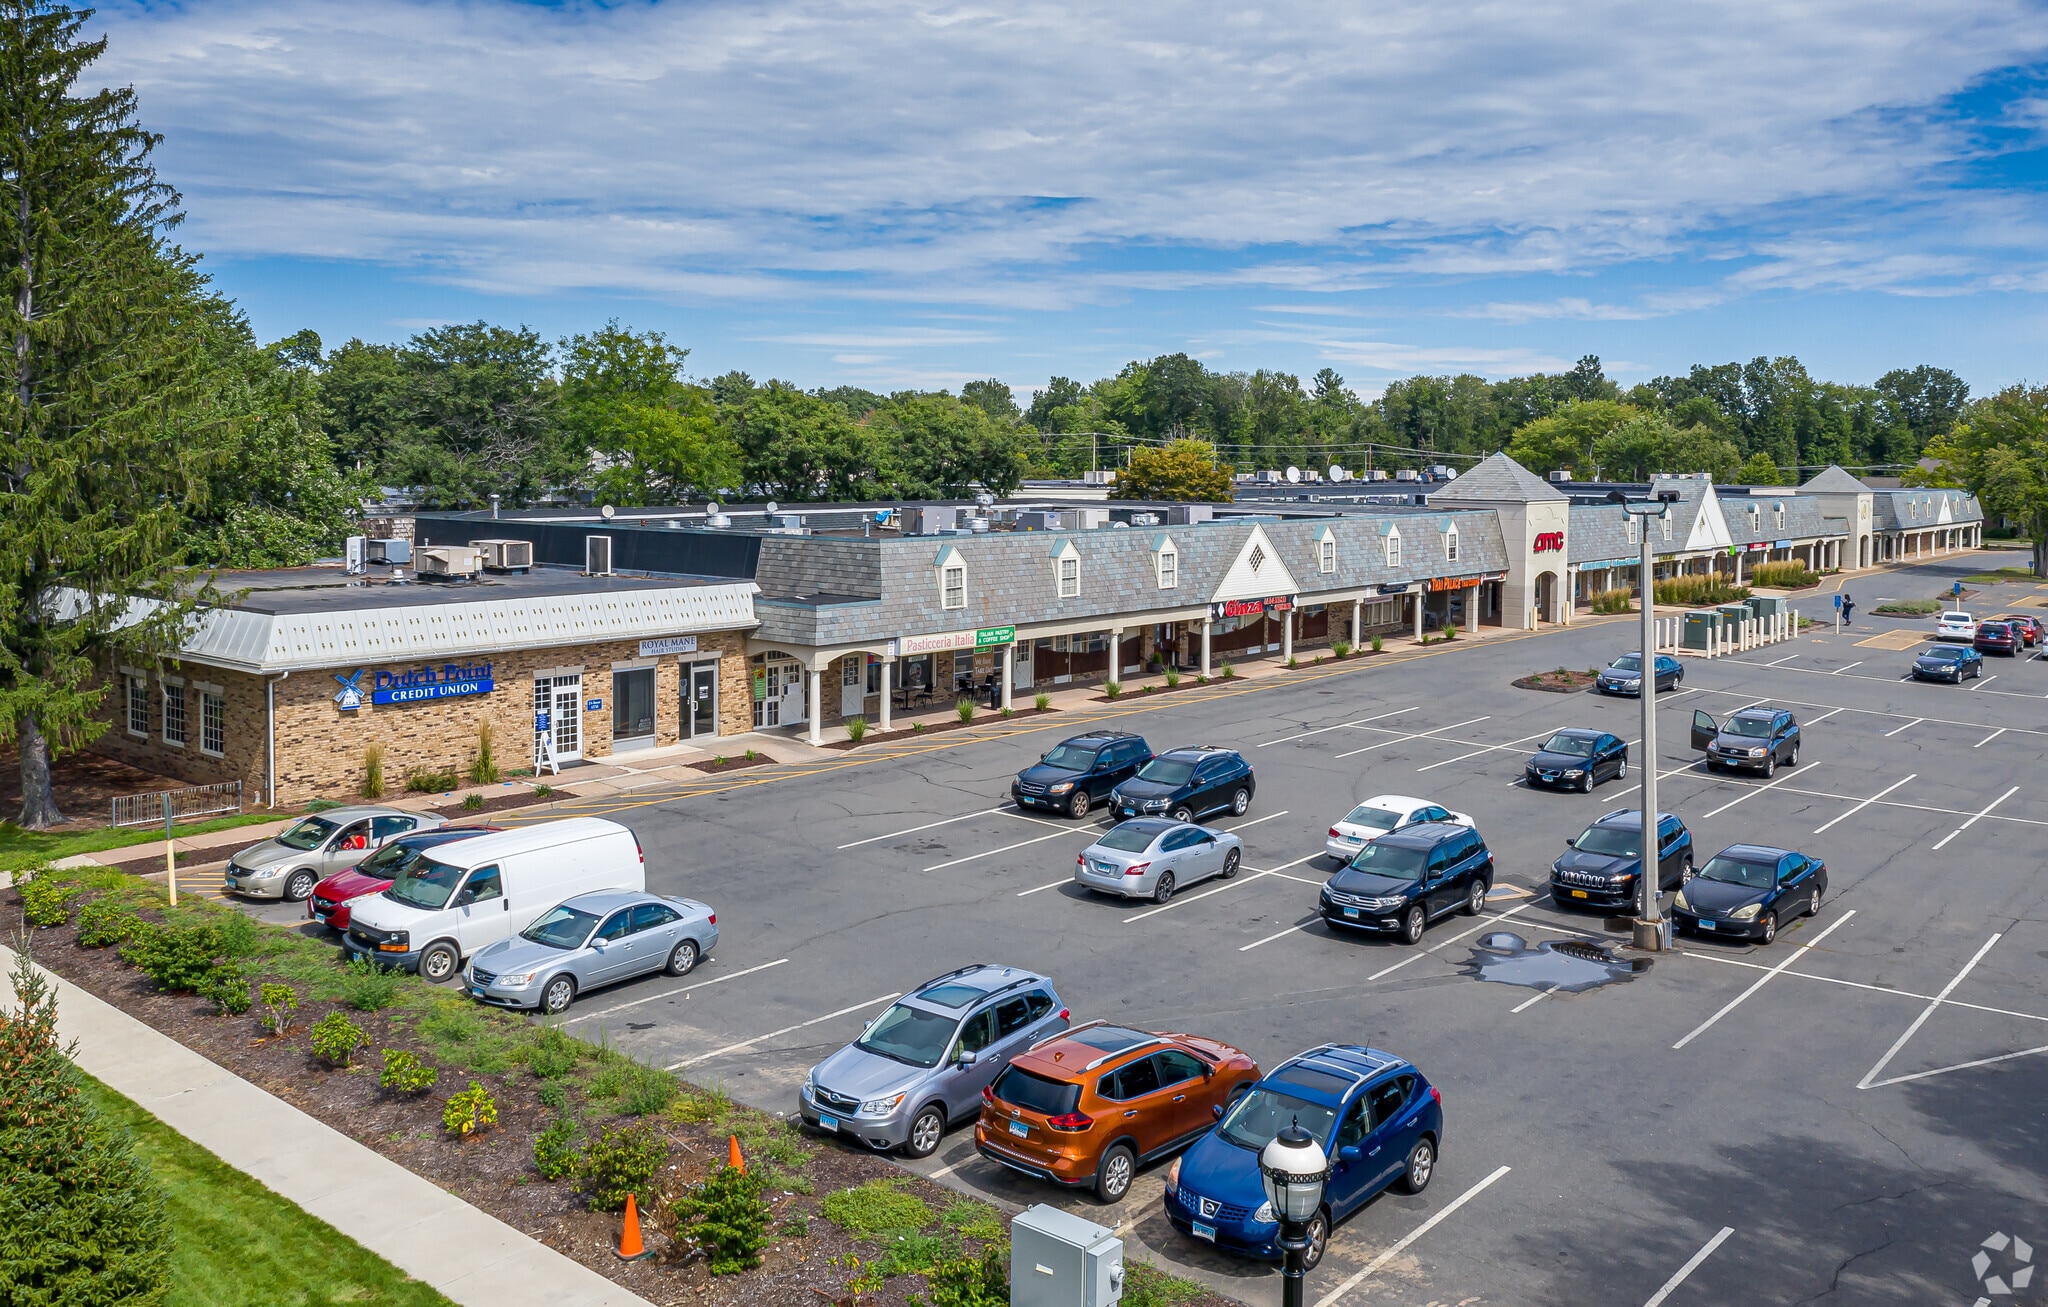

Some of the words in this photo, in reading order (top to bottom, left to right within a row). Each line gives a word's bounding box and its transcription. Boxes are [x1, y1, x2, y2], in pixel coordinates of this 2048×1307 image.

[1226, 600, 1262, 617] Ginza
[641, 639, 669, 650] ROYAL
[671, 637, 695, 647] MANE
[907, 636, 952, 652] Pasticceria
[955, 633, 975, 647] Italia
[374, 666, 436, 690] Dutch
[443, 662, 493, 682] Point
[391, 687, 435, 701] CREDIT
[440, 682, 478, 695] UNION
